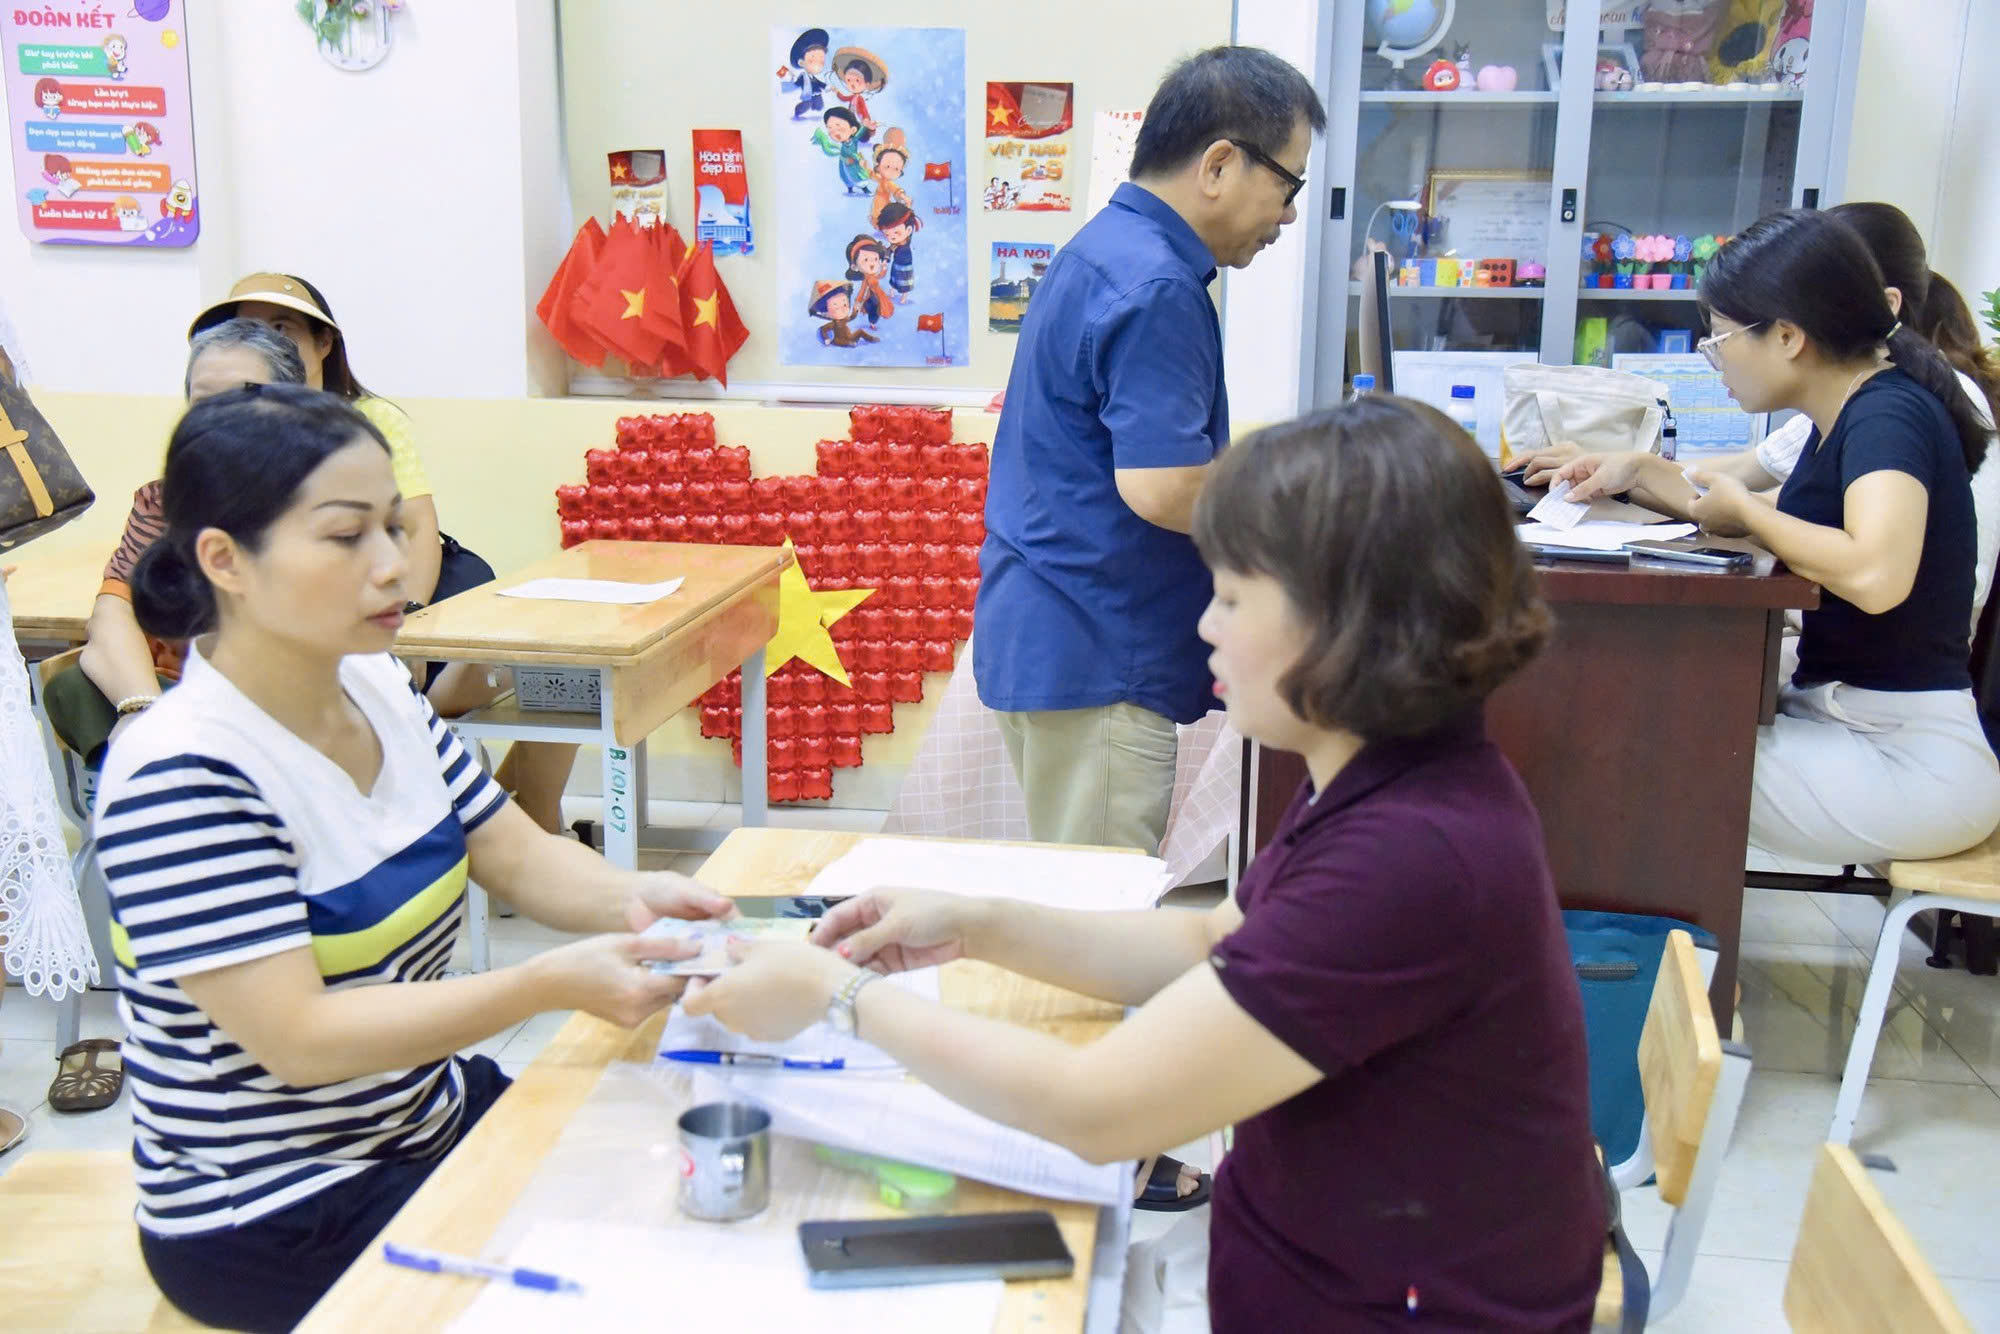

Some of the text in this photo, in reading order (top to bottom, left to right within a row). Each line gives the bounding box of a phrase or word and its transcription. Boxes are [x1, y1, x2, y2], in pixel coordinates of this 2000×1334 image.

[13, 4, 115, 29] ĐOÀN KẾT
[699, 150, 721, 162] Hòa
[989, 141, 1068, 159] VIỆT NAM
[700, 163, 723, 176] đẹp
[39, 208, 61, 218] Luôn
[997, 245, 1019, 257] HÀ
